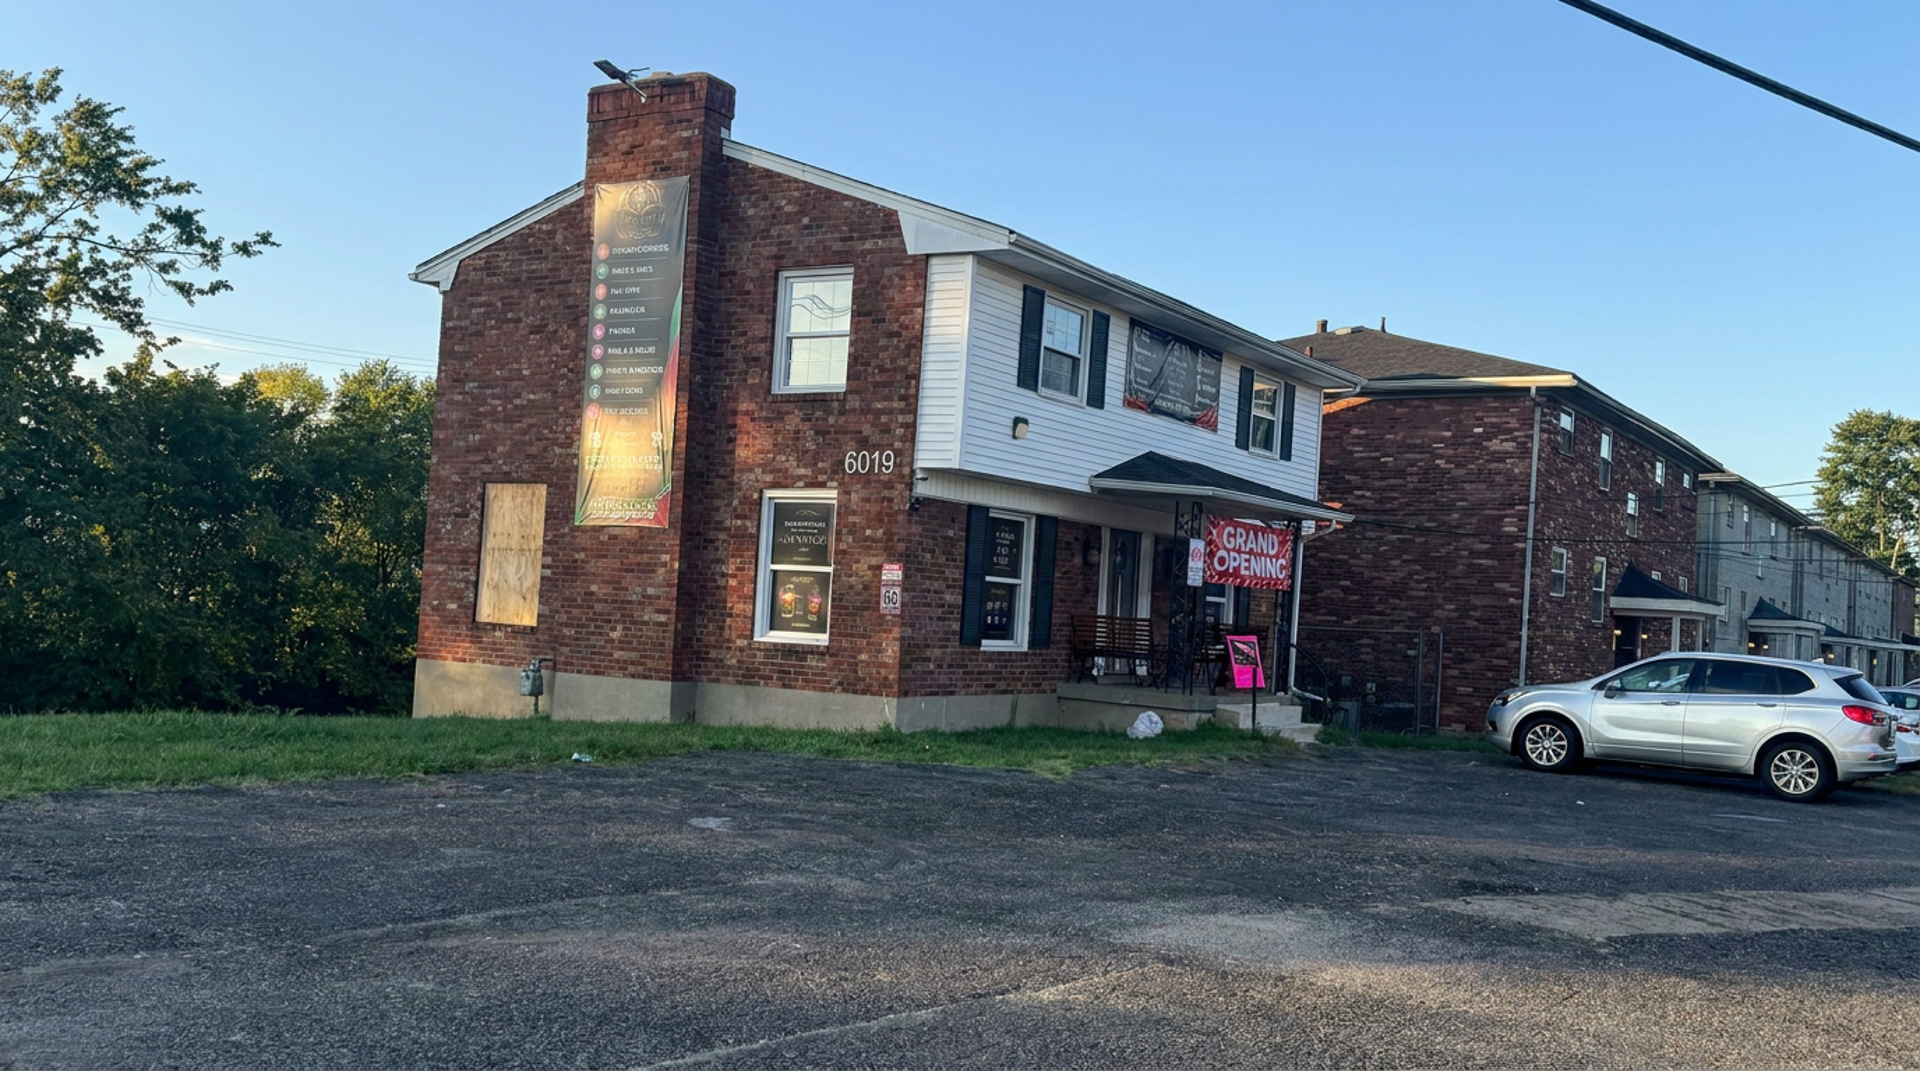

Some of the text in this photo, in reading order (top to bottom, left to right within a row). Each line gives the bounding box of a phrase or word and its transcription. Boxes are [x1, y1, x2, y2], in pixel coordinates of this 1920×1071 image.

[844, 449, 895, 474] 6019
[1222, 526, 1279, 556] GRAND
[1213, 549, 1287, 580] OPENING
